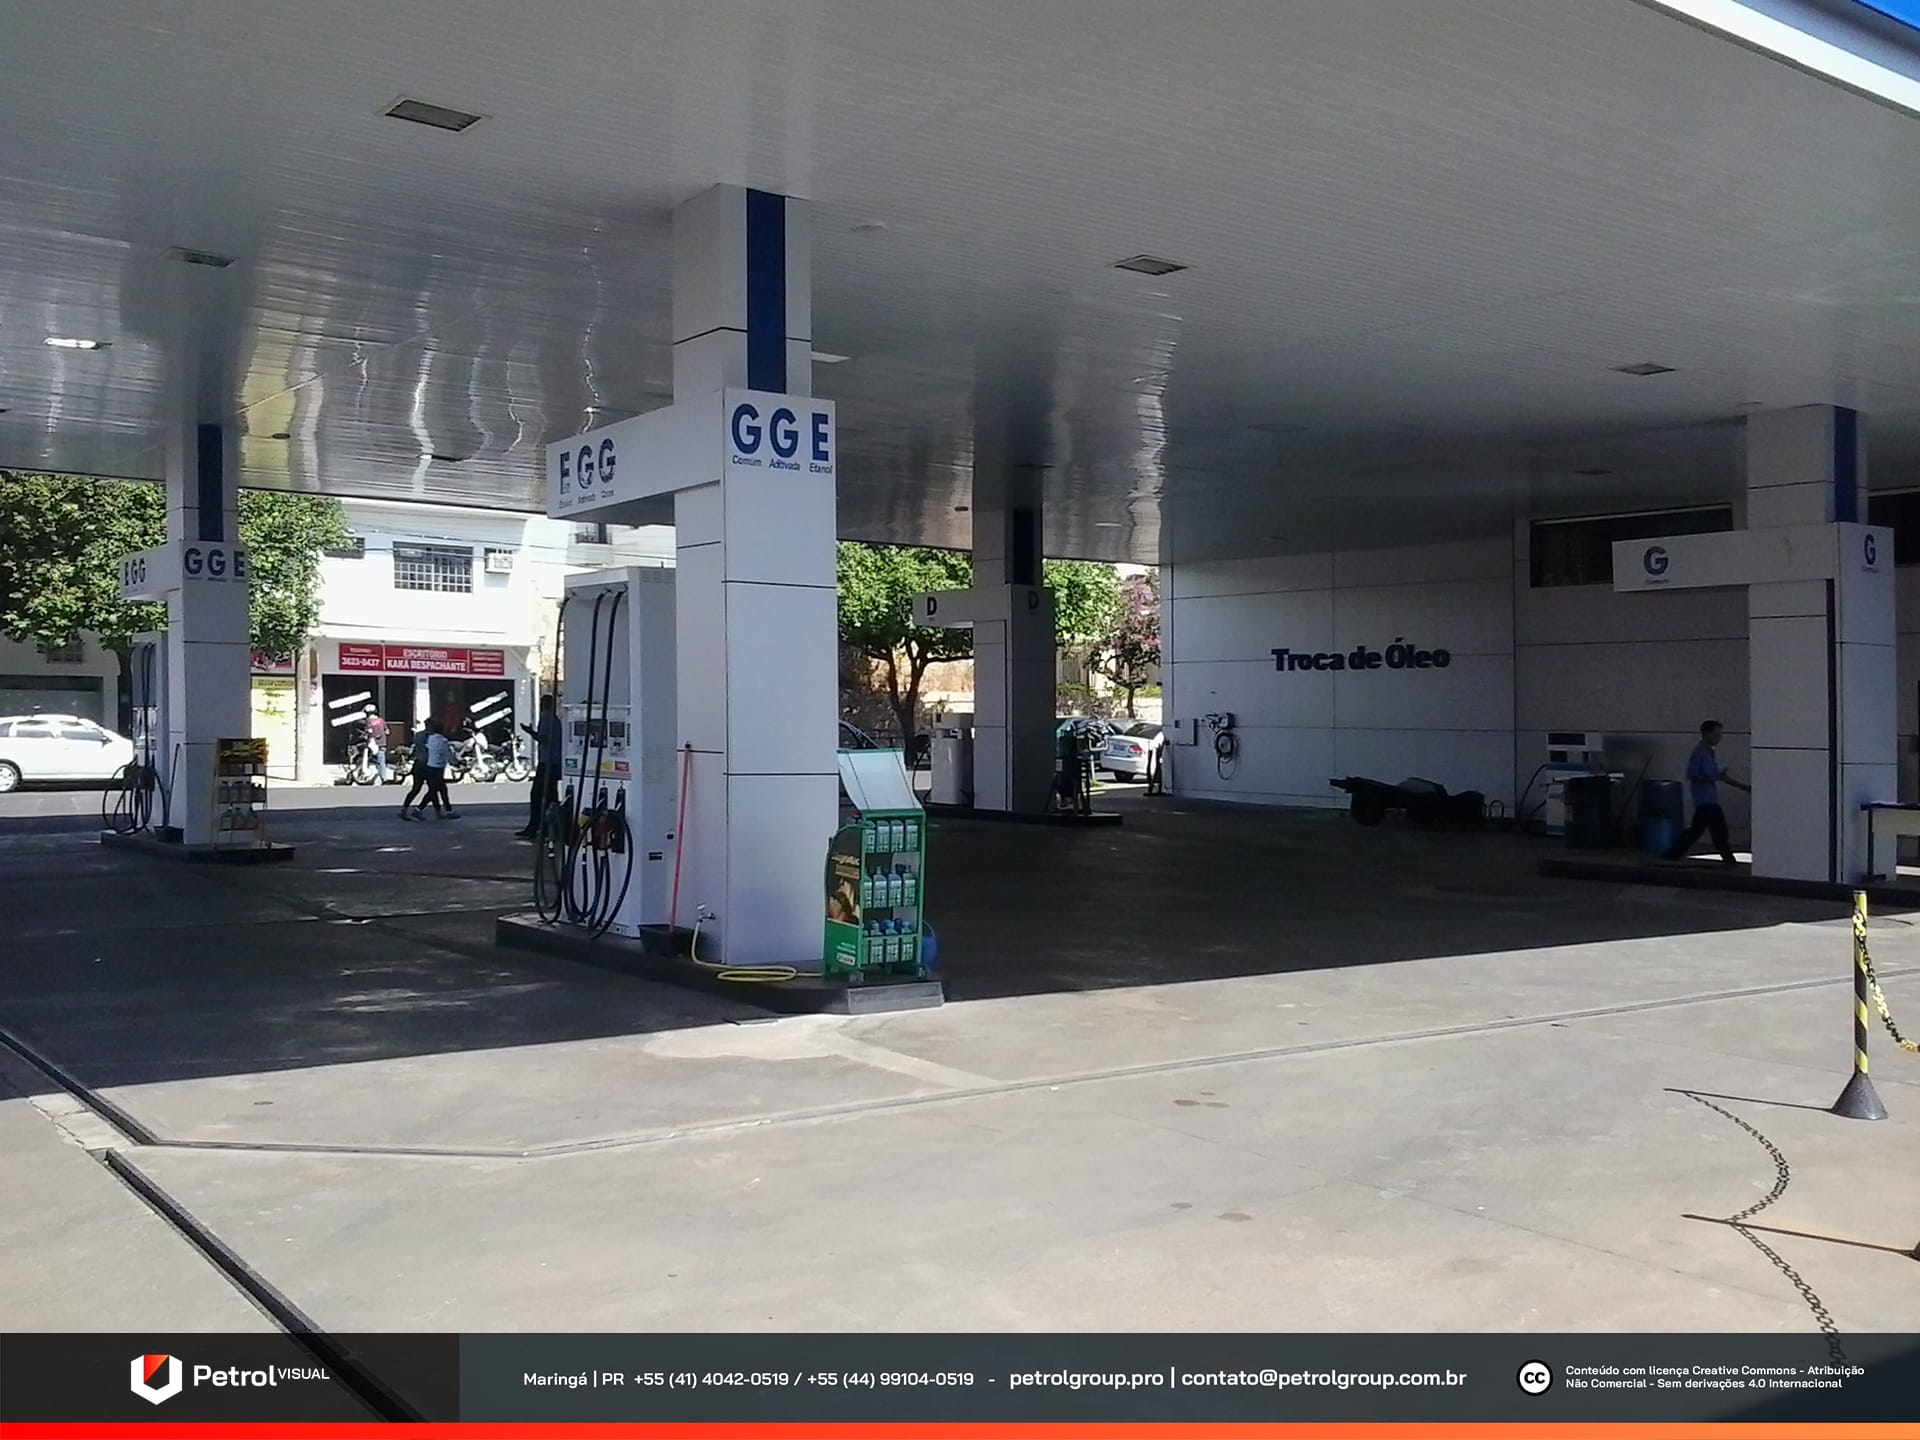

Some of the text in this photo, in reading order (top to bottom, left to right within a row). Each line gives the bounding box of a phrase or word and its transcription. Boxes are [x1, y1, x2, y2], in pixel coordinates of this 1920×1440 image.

[731, 454, 832, 475] Comum Aditivada Etanol
[1643, 546, 1669, 576] G
[1863, 533, 1876, 565] G
[926, 596, 938, 616] D
[1028, 590, 1039, 610] D
[1271, 637, 1450, 672] Troca de Óleo
